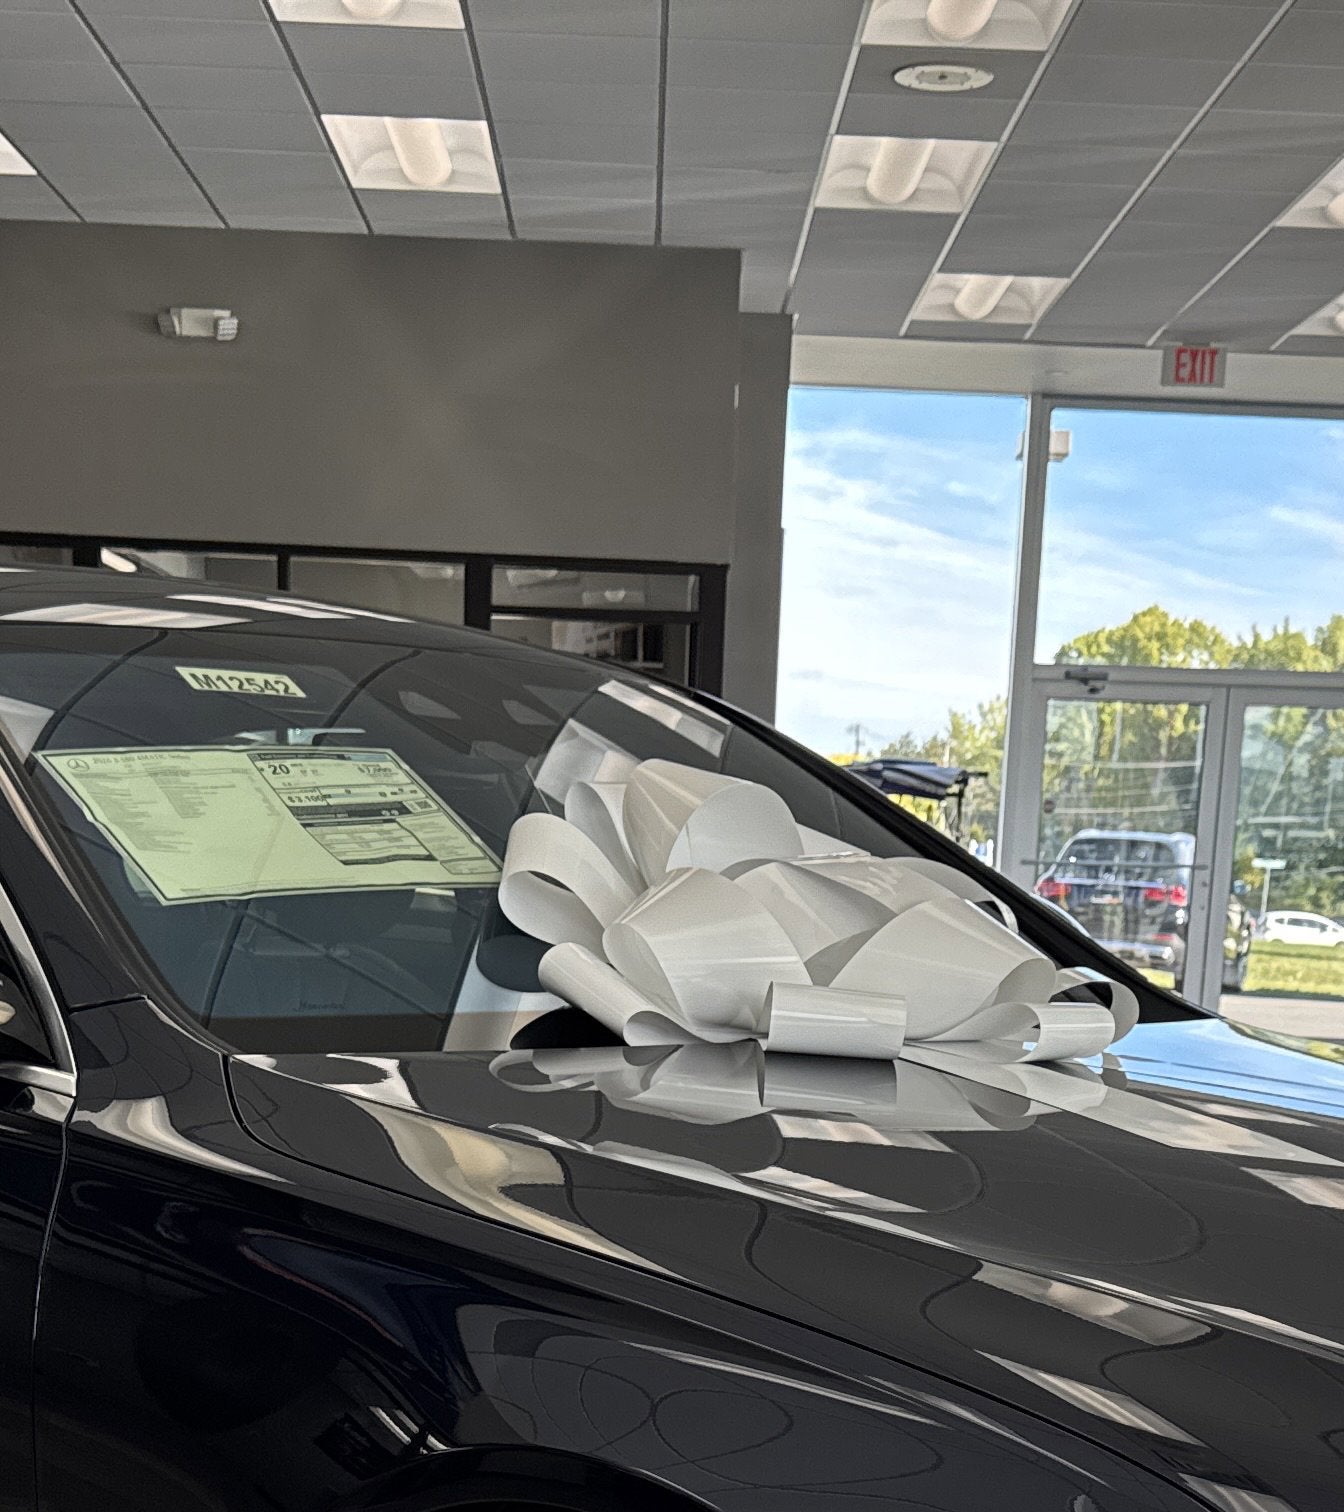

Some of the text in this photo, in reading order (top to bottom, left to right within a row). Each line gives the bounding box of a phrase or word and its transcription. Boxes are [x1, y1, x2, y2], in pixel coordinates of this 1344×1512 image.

[1174, 347, 1218, 384] EXIT
[189, 673, 297, 696] M12542
[268, 764, 290, 775] 20
